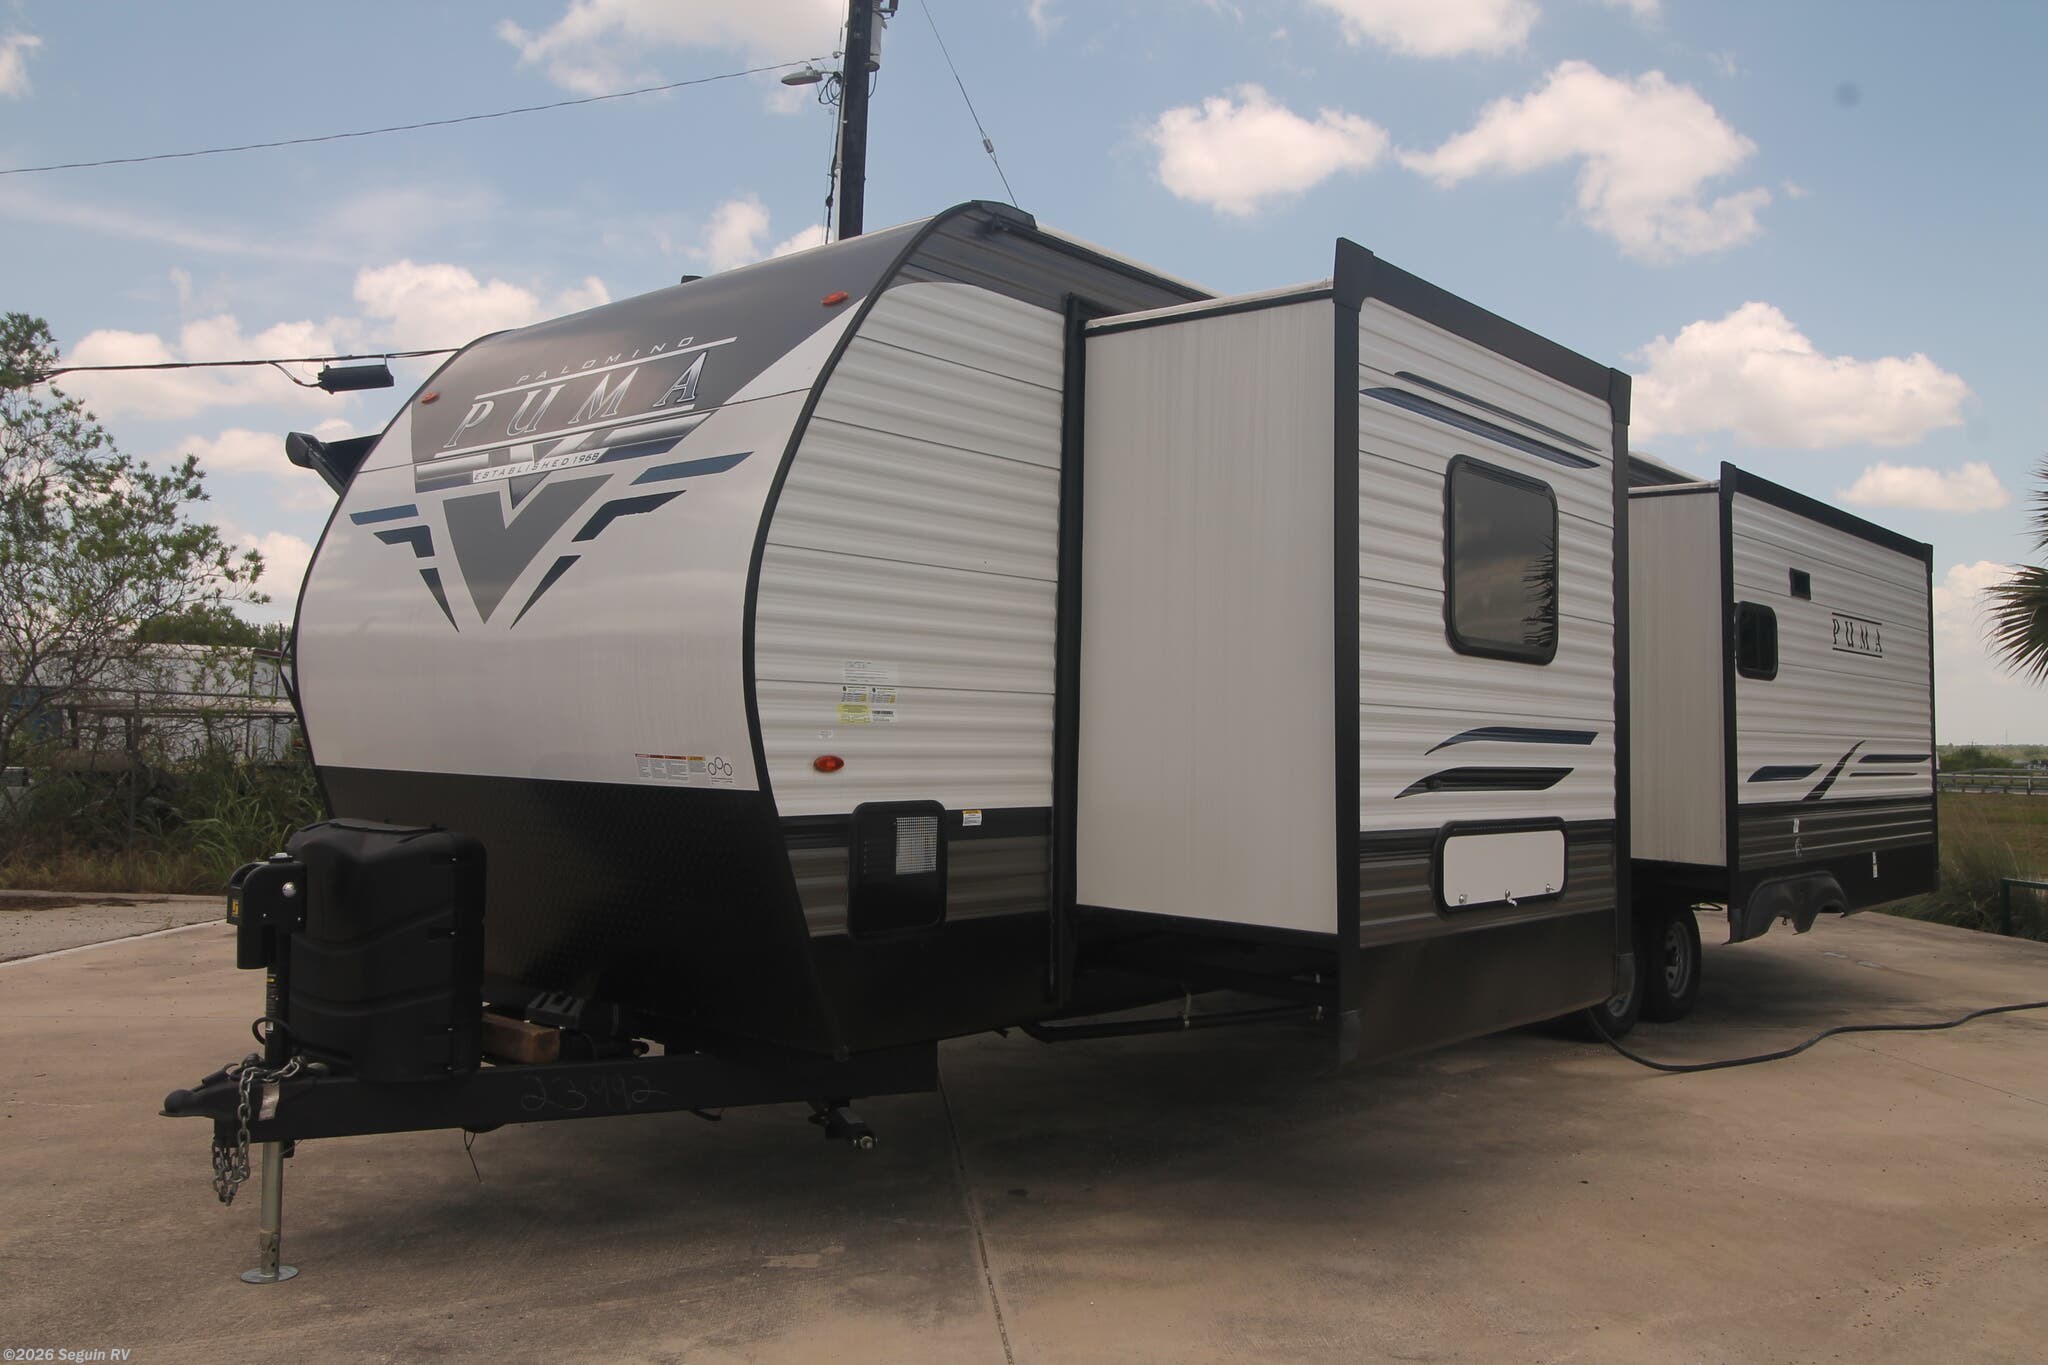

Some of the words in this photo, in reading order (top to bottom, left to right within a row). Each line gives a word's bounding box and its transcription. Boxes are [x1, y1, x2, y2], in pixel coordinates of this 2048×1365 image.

[516, 336, 696, 385] PALOMINO
[443, 351, 709, 449] PUMA
[474, 457, 570, 481] ESTABLISHED
[572, 452, 602, 466] 1968
[1831, 618, 1883, 653] PUMA
